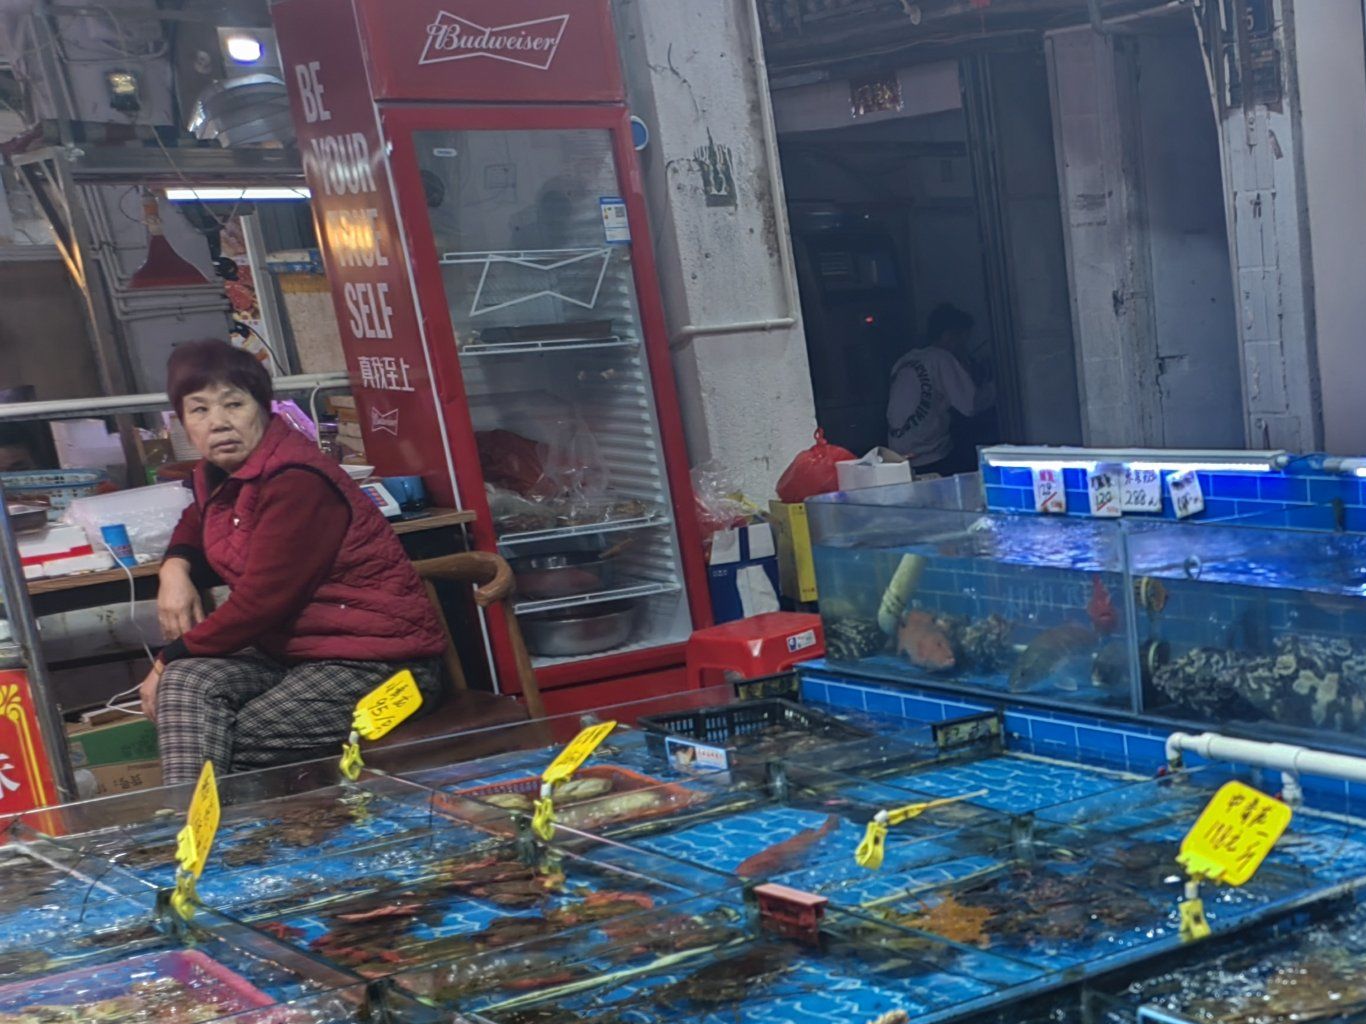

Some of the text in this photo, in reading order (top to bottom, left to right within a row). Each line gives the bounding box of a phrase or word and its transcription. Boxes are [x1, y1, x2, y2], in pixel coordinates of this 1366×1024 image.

[426, 24, 557, 51] Budweiser
[295, 61, 331, 123] BE
[311, 132, 377, 196] YOUR
[326, 208, 389, 267] TRUE
[344, 282, 393, 339] SELF
